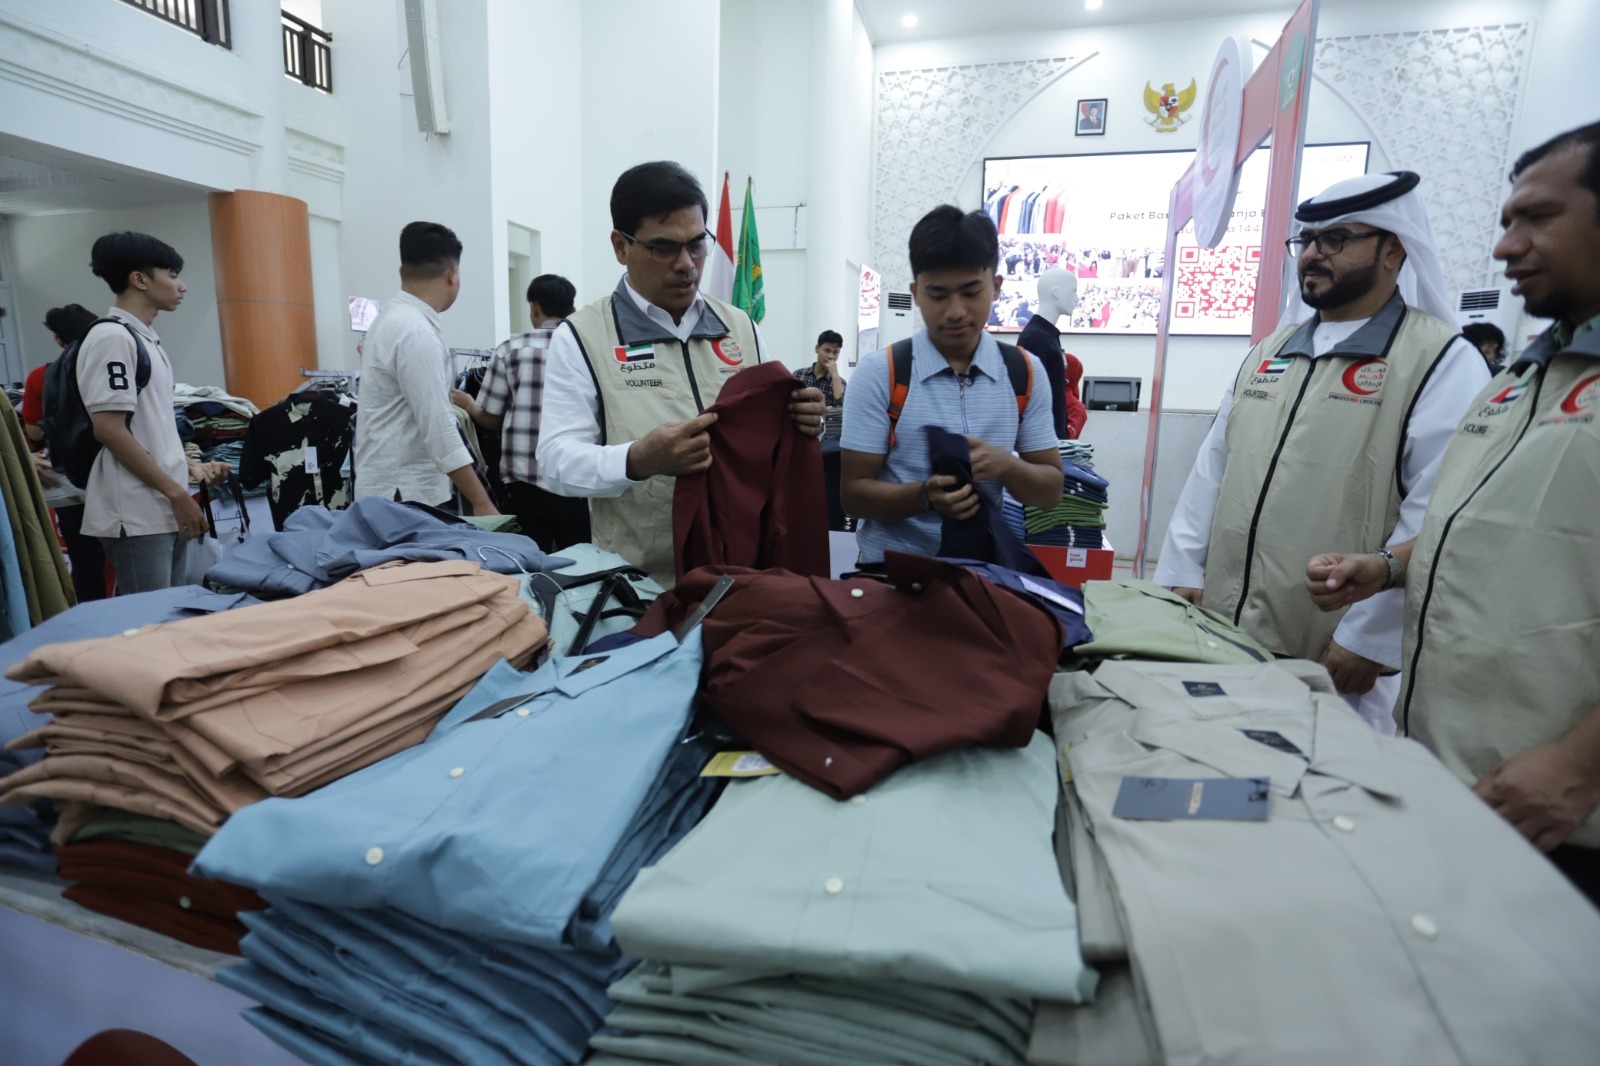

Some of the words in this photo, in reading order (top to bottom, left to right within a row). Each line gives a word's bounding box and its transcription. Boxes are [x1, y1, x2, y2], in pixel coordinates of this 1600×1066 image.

[1110, 211, 1145, 221] Paket
[106, 361, 130, 391] 8
[624, 379, 663, 387] VOLUNTEER
